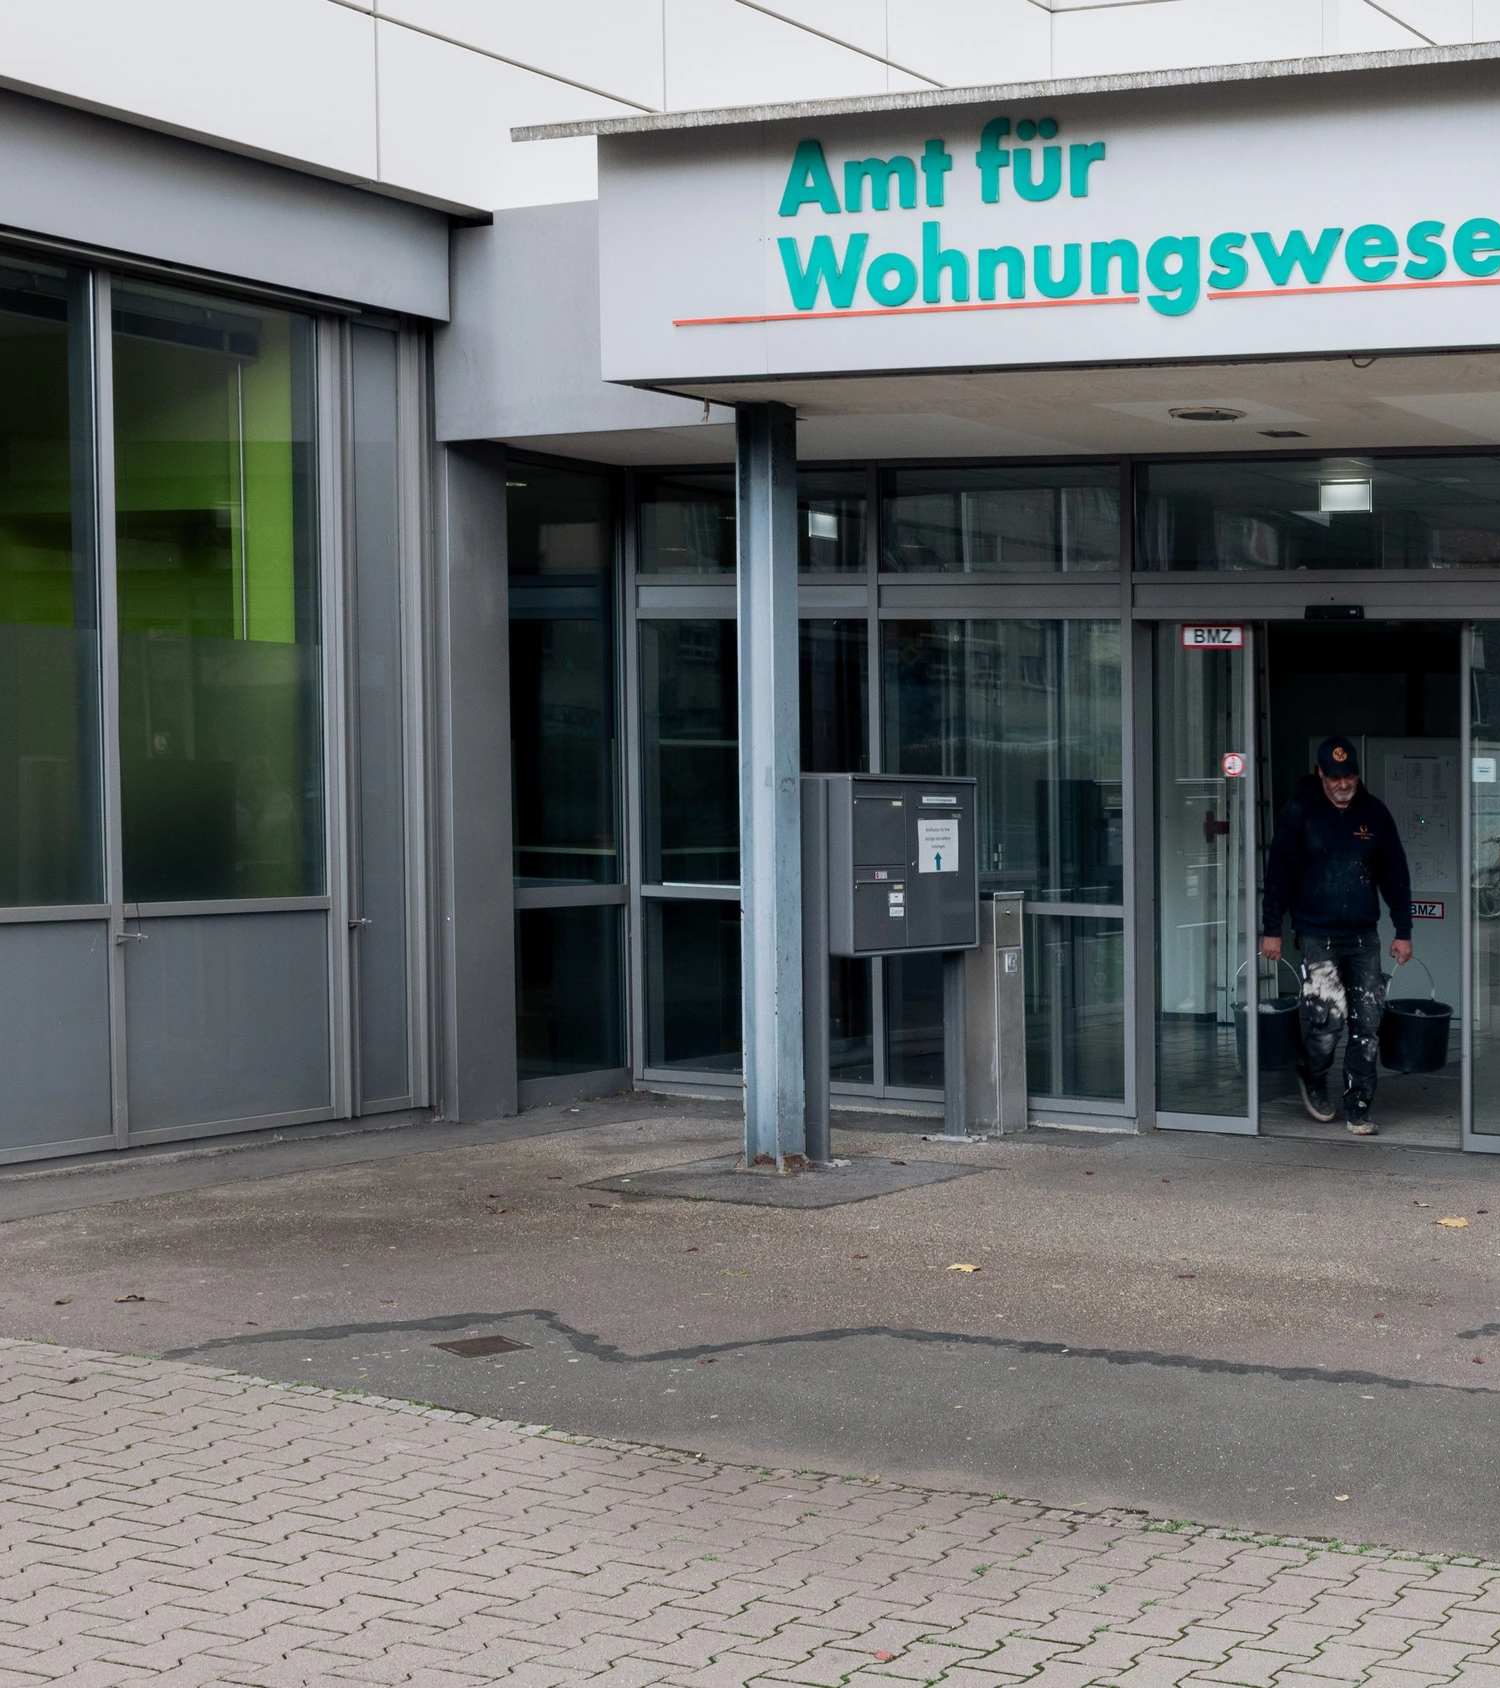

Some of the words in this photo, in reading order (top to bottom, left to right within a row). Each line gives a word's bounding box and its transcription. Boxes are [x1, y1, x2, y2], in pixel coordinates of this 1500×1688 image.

[777, 138, 953, 217] Amt
[974, 117, 1107, 204] für
[1193, 628, 1233, 645] BMZ
[1411, 904, 1437, 916] BMZ
